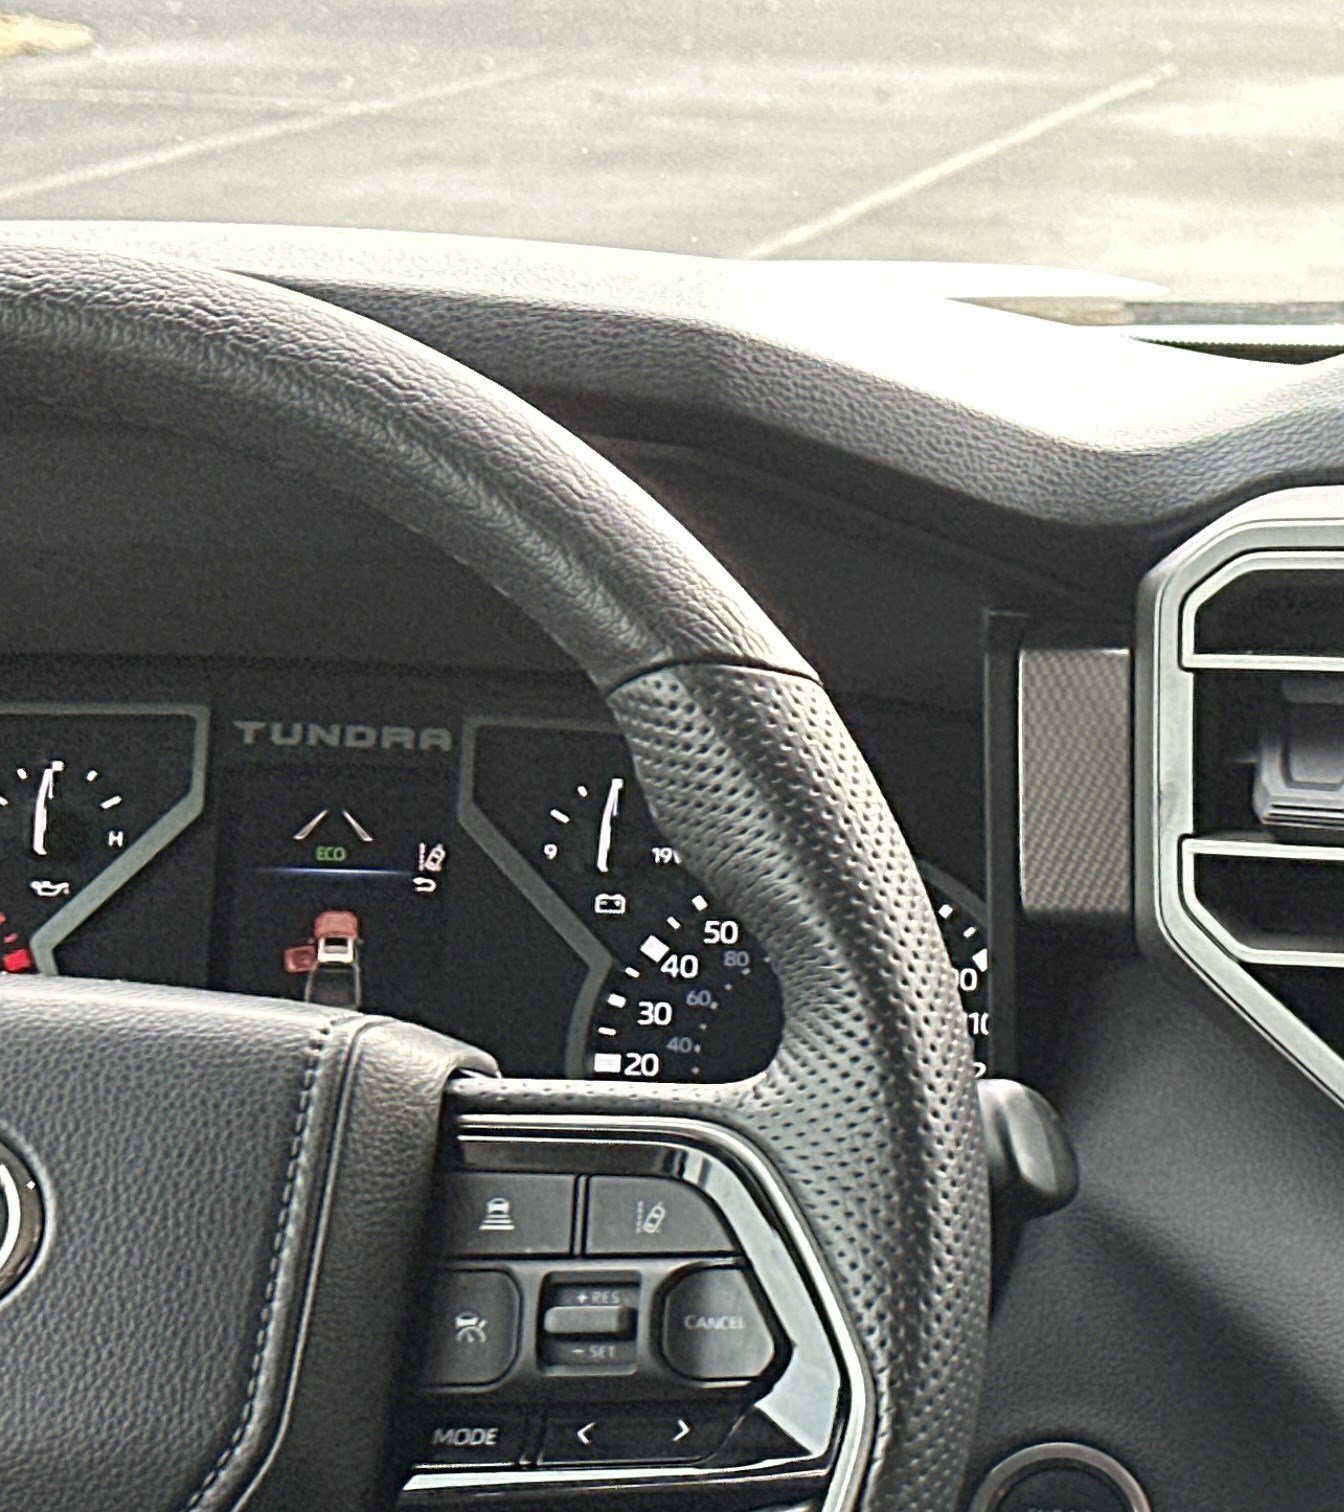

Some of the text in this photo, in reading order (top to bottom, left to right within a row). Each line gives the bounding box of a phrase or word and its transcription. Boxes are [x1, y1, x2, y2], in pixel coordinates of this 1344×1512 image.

[232, 720, 453, 752] TUNDRA
[108, 831, 123, 848] H
[316, 846, 346, 862] ECO
[544, 844, 557, 861] 9
[703, 920, 738, 944] 50
[661, 954, 698, 978] 40
[723, 951, 749, 968] 80
[686, 990, 711, 1006] 60
[637, 1001, 672, 1025] 30
[666, 1037, 691, 1053] 40
[624, 1053, 659, 1077] 20
[684, 1315, 746, 1330] CANCEL
[433, 1427, 499, 1447] MODE
